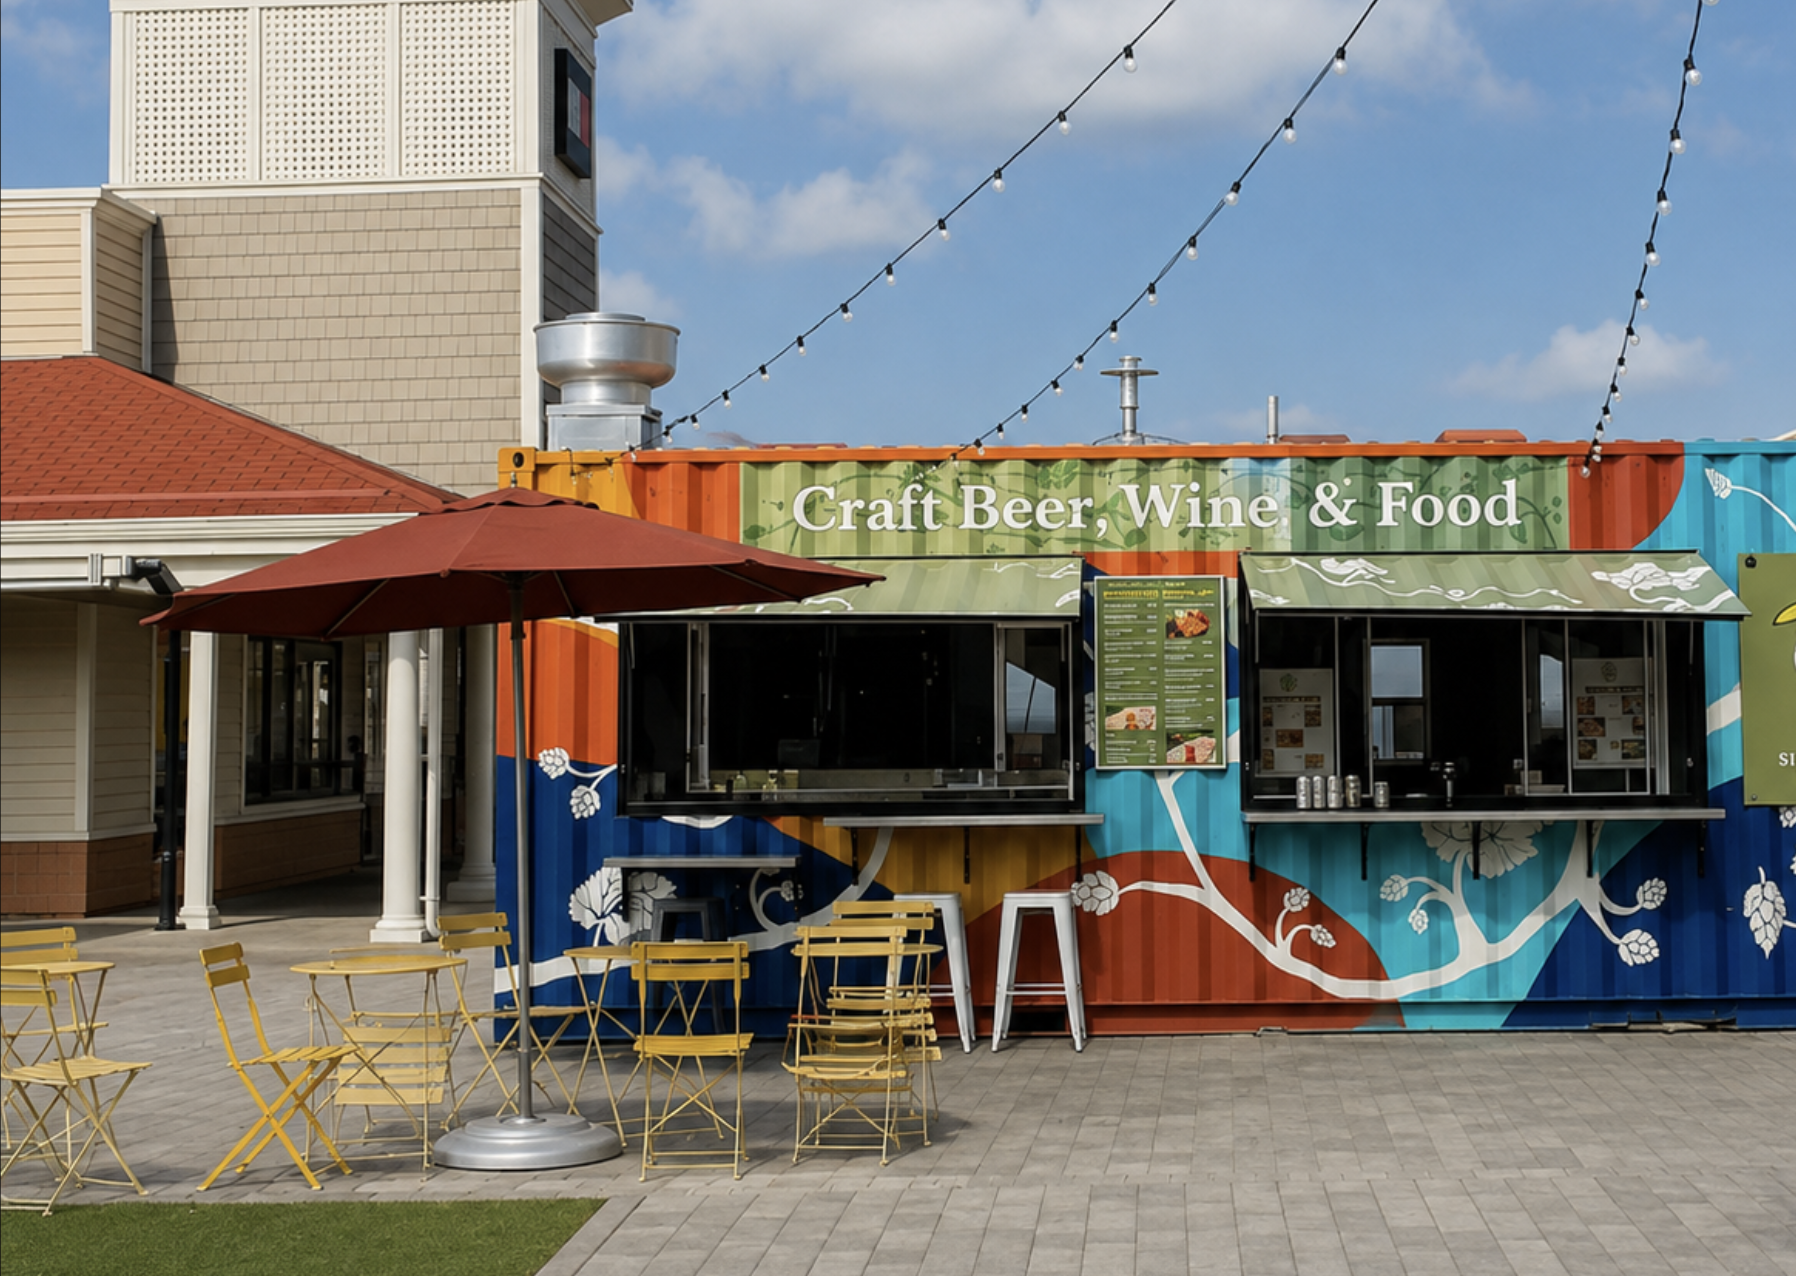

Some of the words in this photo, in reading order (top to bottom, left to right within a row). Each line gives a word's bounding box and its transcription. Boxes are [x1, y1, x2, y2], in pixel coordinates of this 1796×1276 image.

[793, 483, 942, 531] Craft
[959, 484, 1108, 538] Beer,
[1118, 481, 1279, 530] Wine
[1308, 478, 1358, 529] &
[1376, 477, 1522, 528] Food
